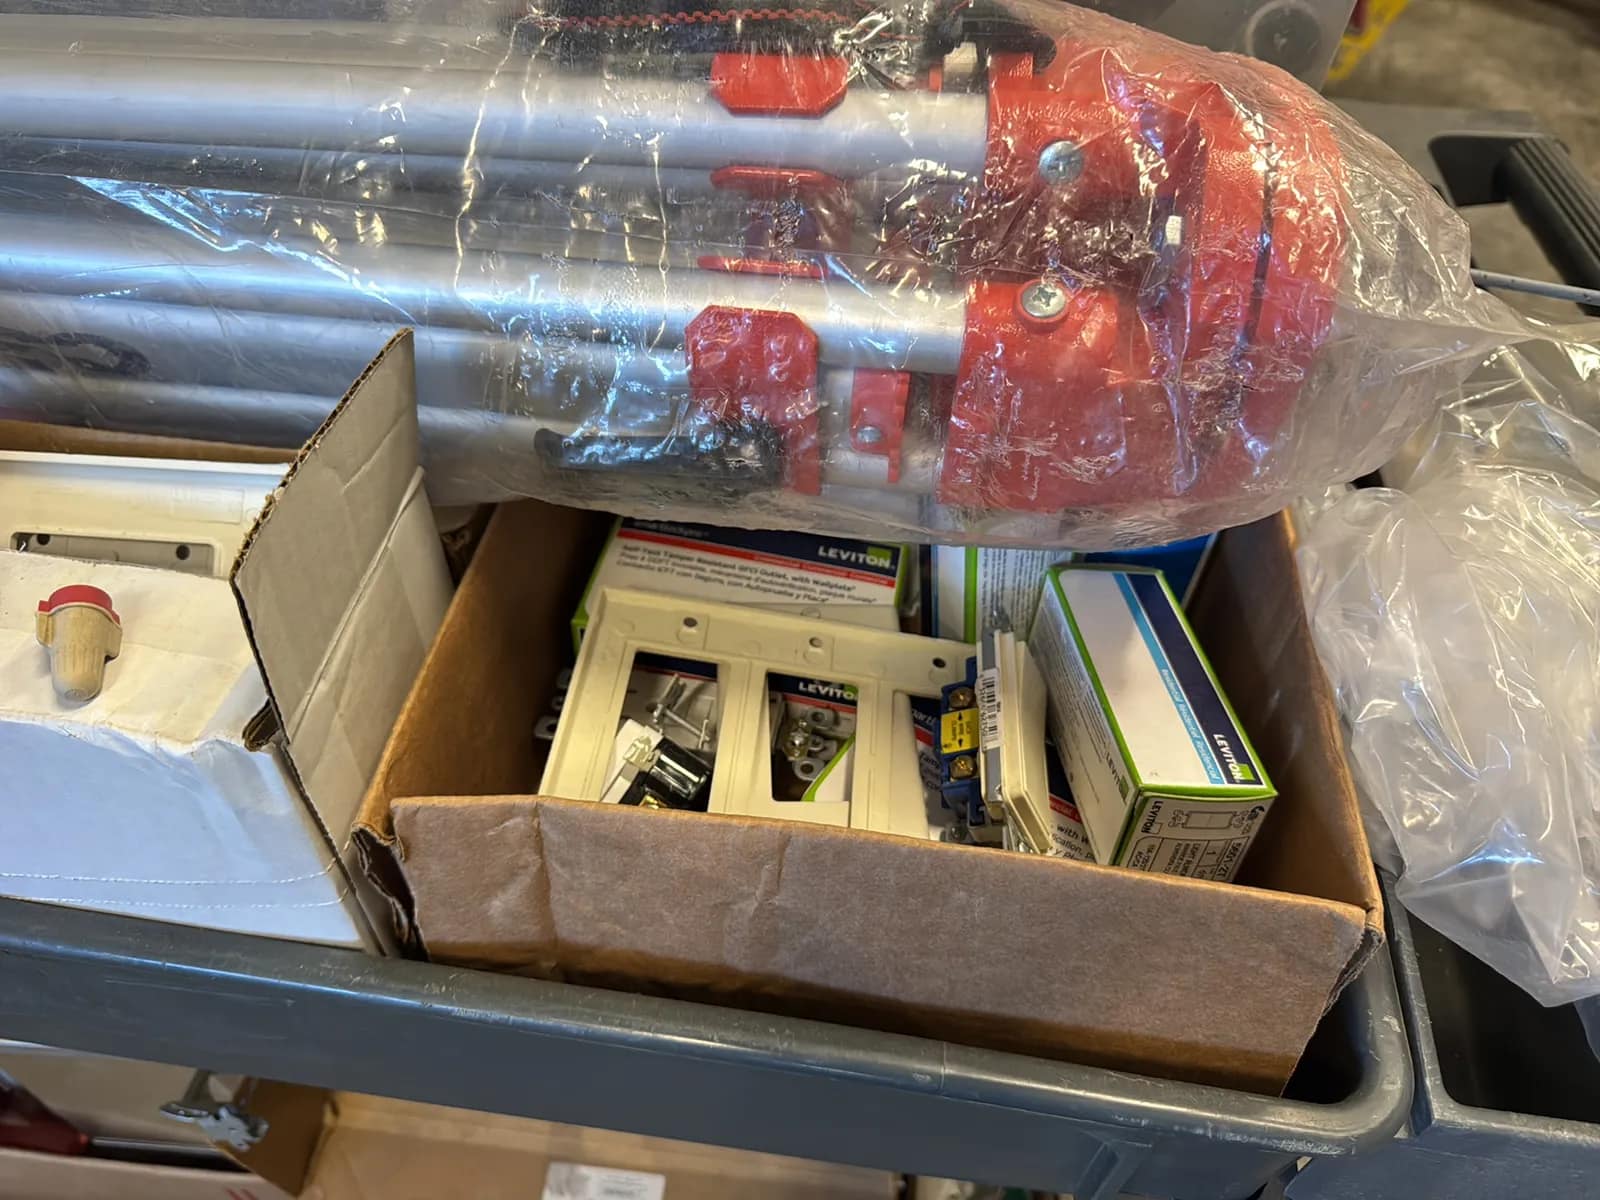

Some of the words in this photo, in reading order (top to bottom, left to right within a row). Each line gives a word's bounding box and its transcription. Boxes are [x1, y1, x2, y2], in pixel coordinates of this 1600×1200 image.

[818, 545, 891, 569] LEVITON
[759, 567, 789, 581] Outlet,
[791, 573, 811, 585] with
[797, 681, 857, 700] LEVITO
[1213, 733, 1244, 781] LEVITON
[1141, 800, 1164, 834] LEVITON
[1056, 825, 1079, 840] with
